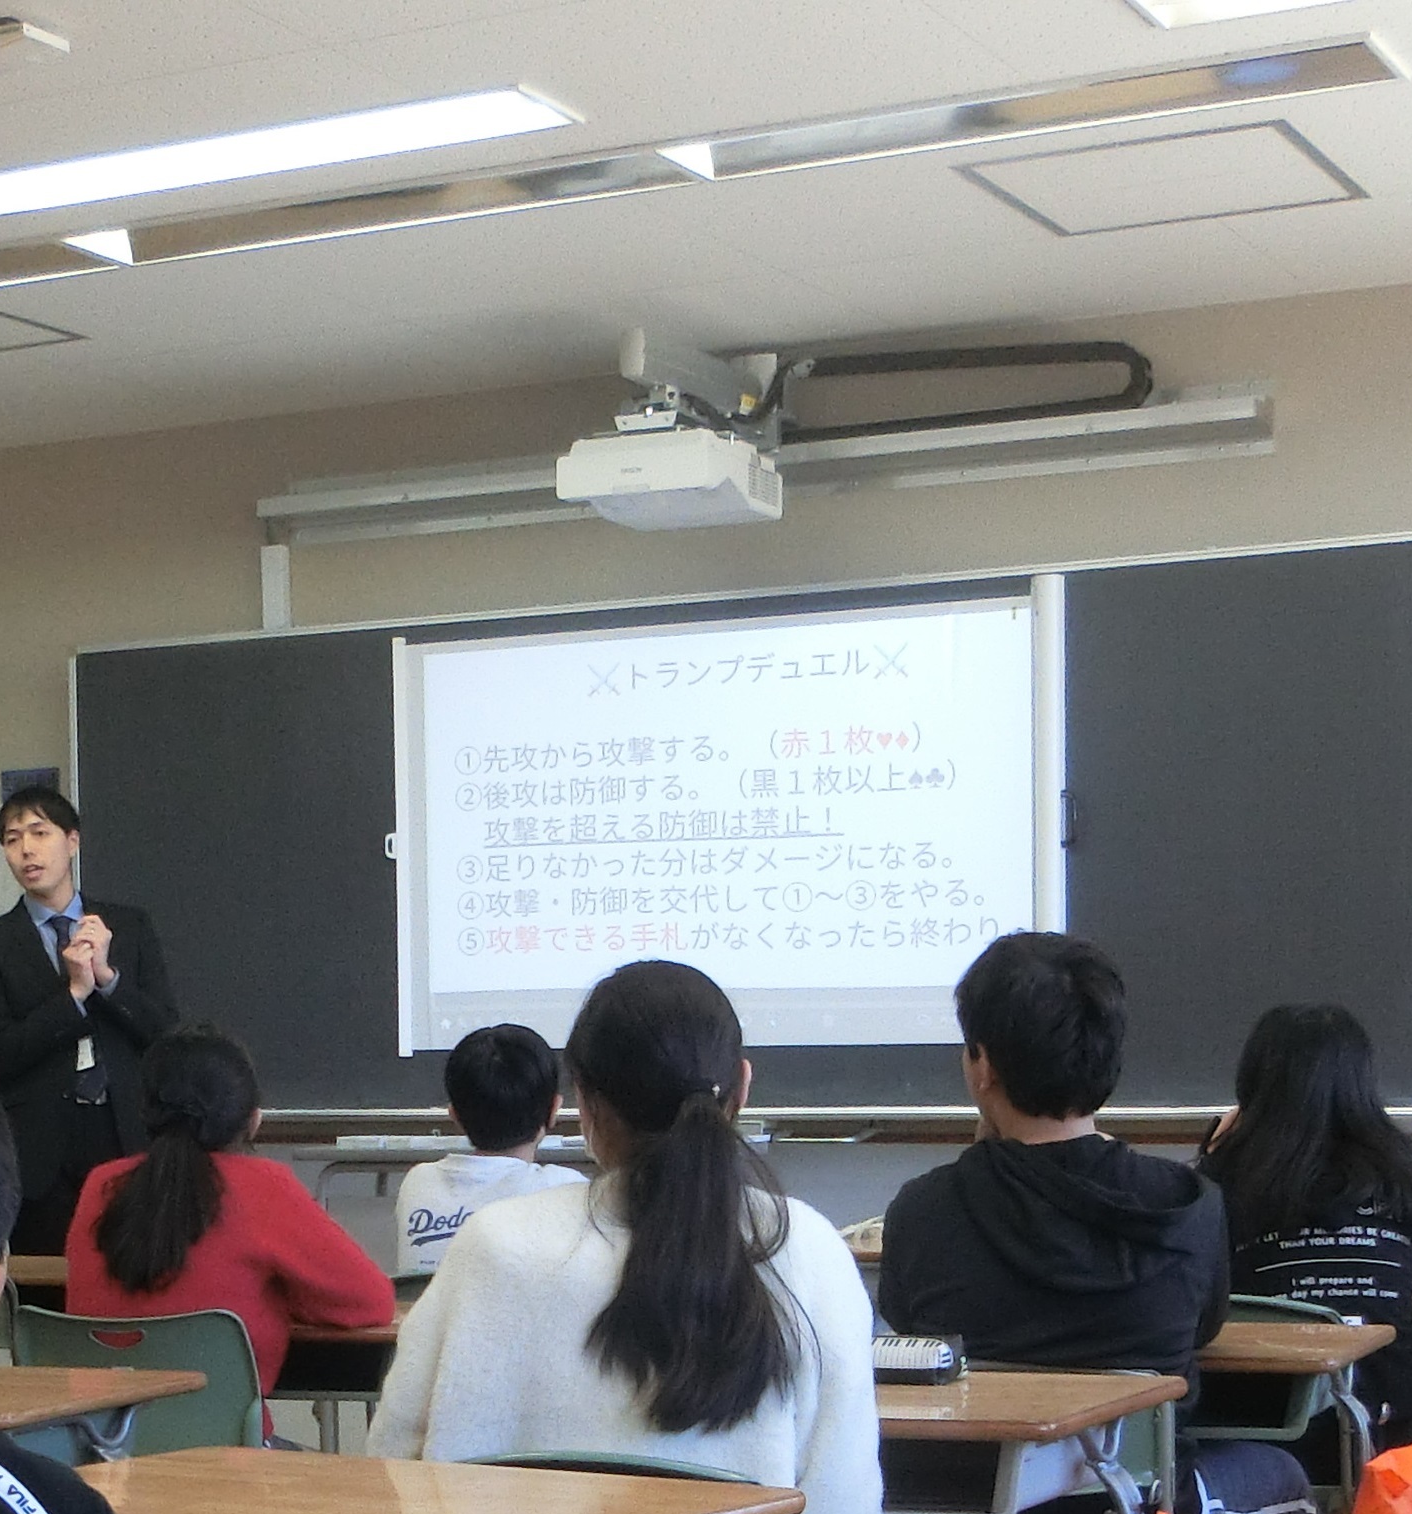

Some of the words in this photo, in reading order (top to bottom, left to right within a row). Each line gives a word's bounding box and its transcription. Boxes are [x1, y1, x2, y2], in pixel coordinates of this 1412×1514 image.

[632, 649, 870, 690] トランプデュエル
[1278, 1239, 1306, 1250] THAN
[1308, 1237, 1335, 1246] YOUR
[1338, 1236, 1377, 1247] DREAMS
[1299, 1276, 1316, 1285] will
[1318, 1277, 1354, 1286] prepare
[1356, 1276, 1374, 1286] and
[1291, 1289, 1308, 1299] day
[1310, 1289, 1325, 1299] my
[1327, 1288, 1359, 1297] chance
[1362, 1288, 1377, 1297] will
